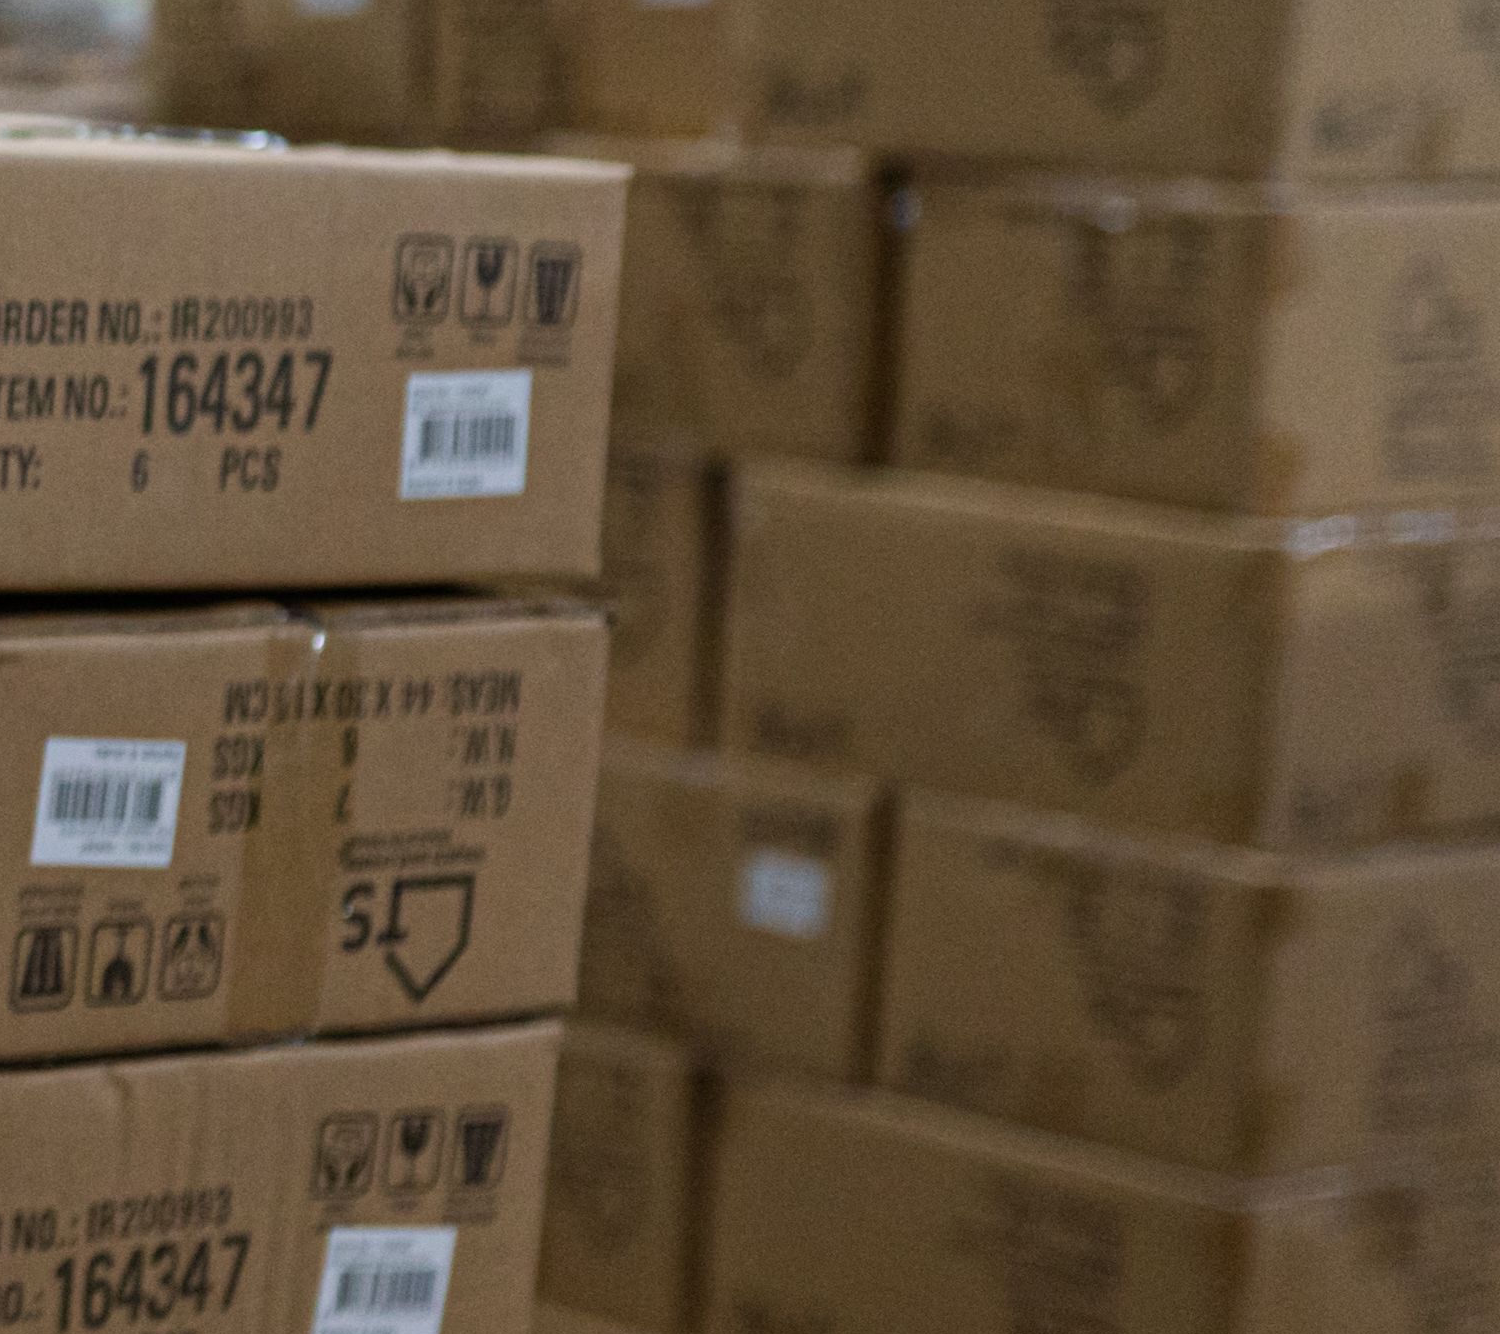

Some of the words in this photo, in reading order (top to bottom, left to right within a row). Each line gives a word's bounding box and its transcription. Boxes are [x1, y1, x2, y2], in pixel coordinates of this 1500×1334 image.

[171, 298, 314, 341] IR200993
[138, 353, 334, 435] 164347
[220, 448, 281, 491] PCS
[52, 1236, 251, 1333] 164347
